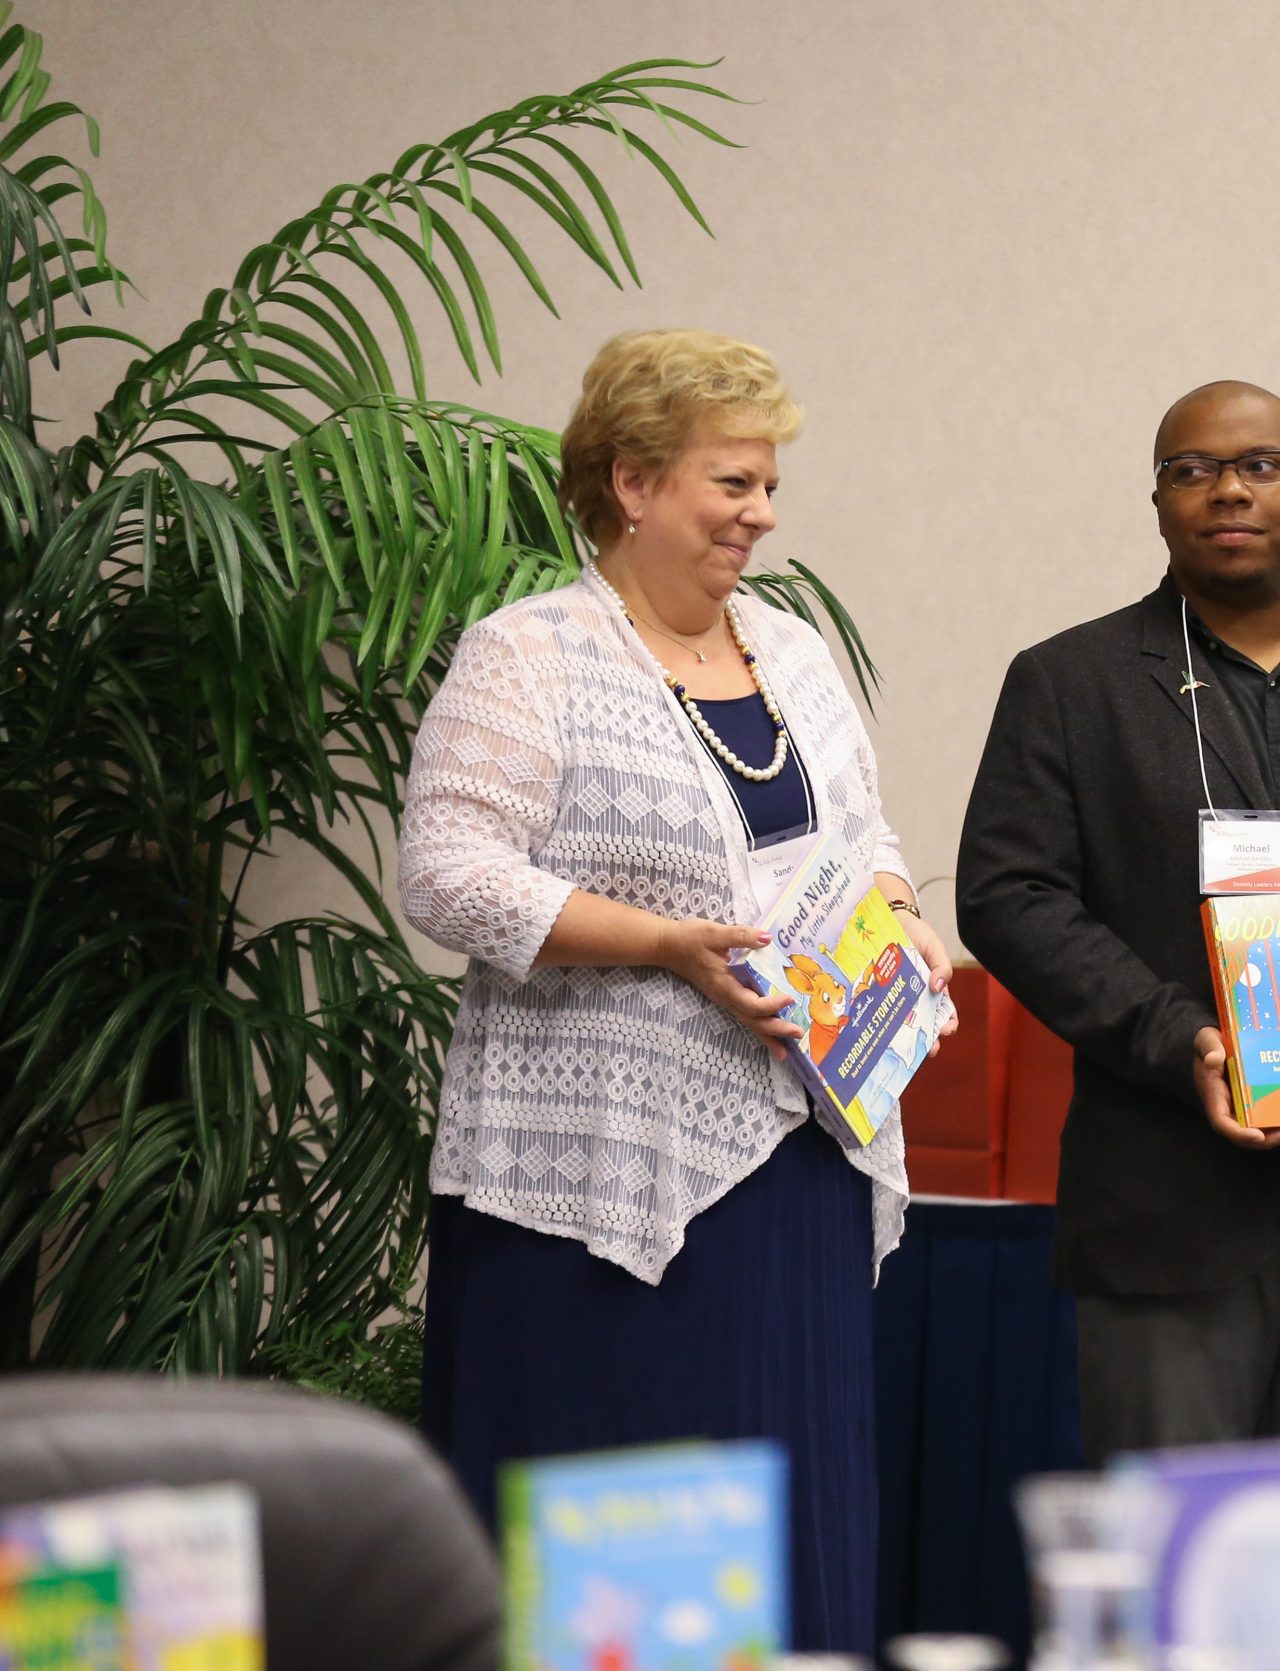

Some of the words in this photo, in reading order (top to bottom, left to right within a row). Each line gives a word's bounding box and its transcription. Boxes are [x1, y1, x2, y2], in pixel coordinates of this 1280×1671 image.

[773, 865, 794, 878] Sand
[1232, 844, 1270, 853] Michael
[777, 902, 808, 948] Good
[804, 859, 842, 908] Night,
[800, 935, 815, 950] My
[808, 914, 825, 937] Little
[821, 872, 850, 916] Sleepyhead
[838, 1023, 876, 1079] RECORDABLE
[872, 975, 906, 1028] STORYBOOK
[852, 995, 874, 1027] Hallmark
